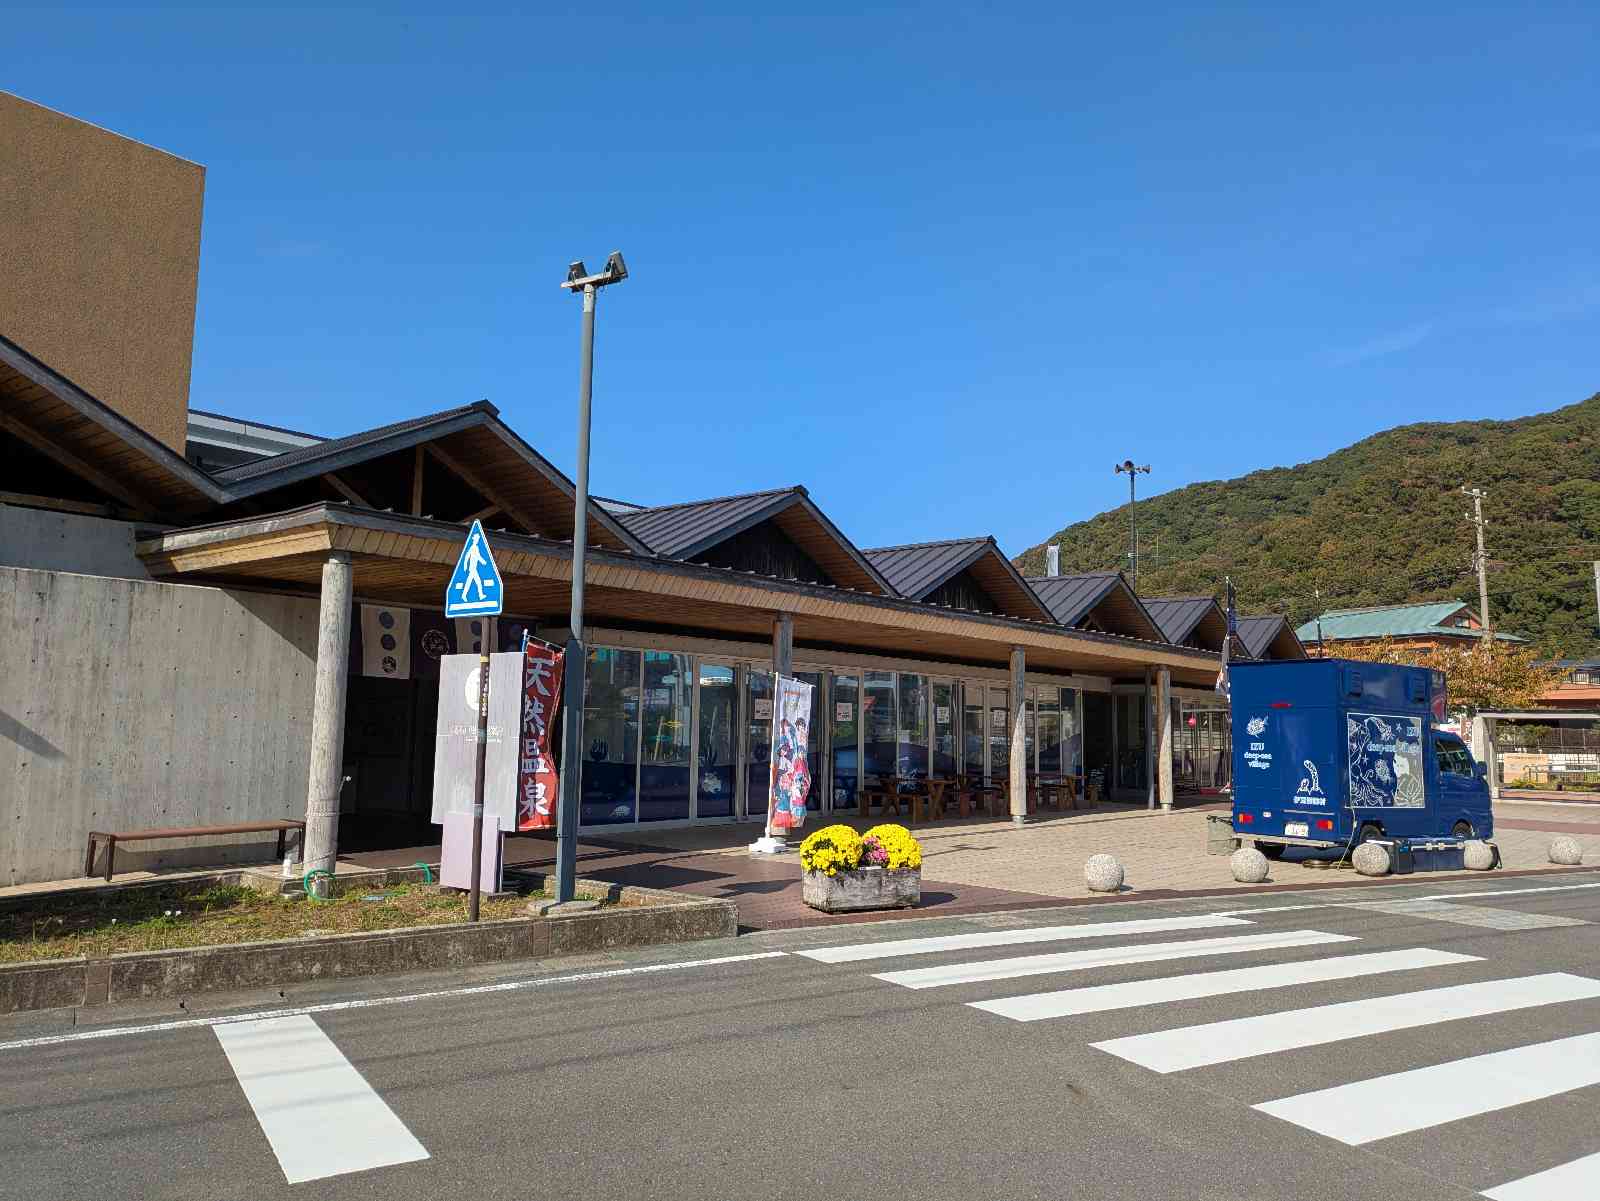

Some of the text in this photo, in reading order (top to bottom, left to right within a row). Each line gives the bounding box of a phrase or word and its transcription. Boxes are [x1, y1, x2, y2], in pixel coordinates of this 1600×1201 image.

[520, 657, 554, 818] 天然温泉
[1244, 751, 1273, 761] deep-sea
